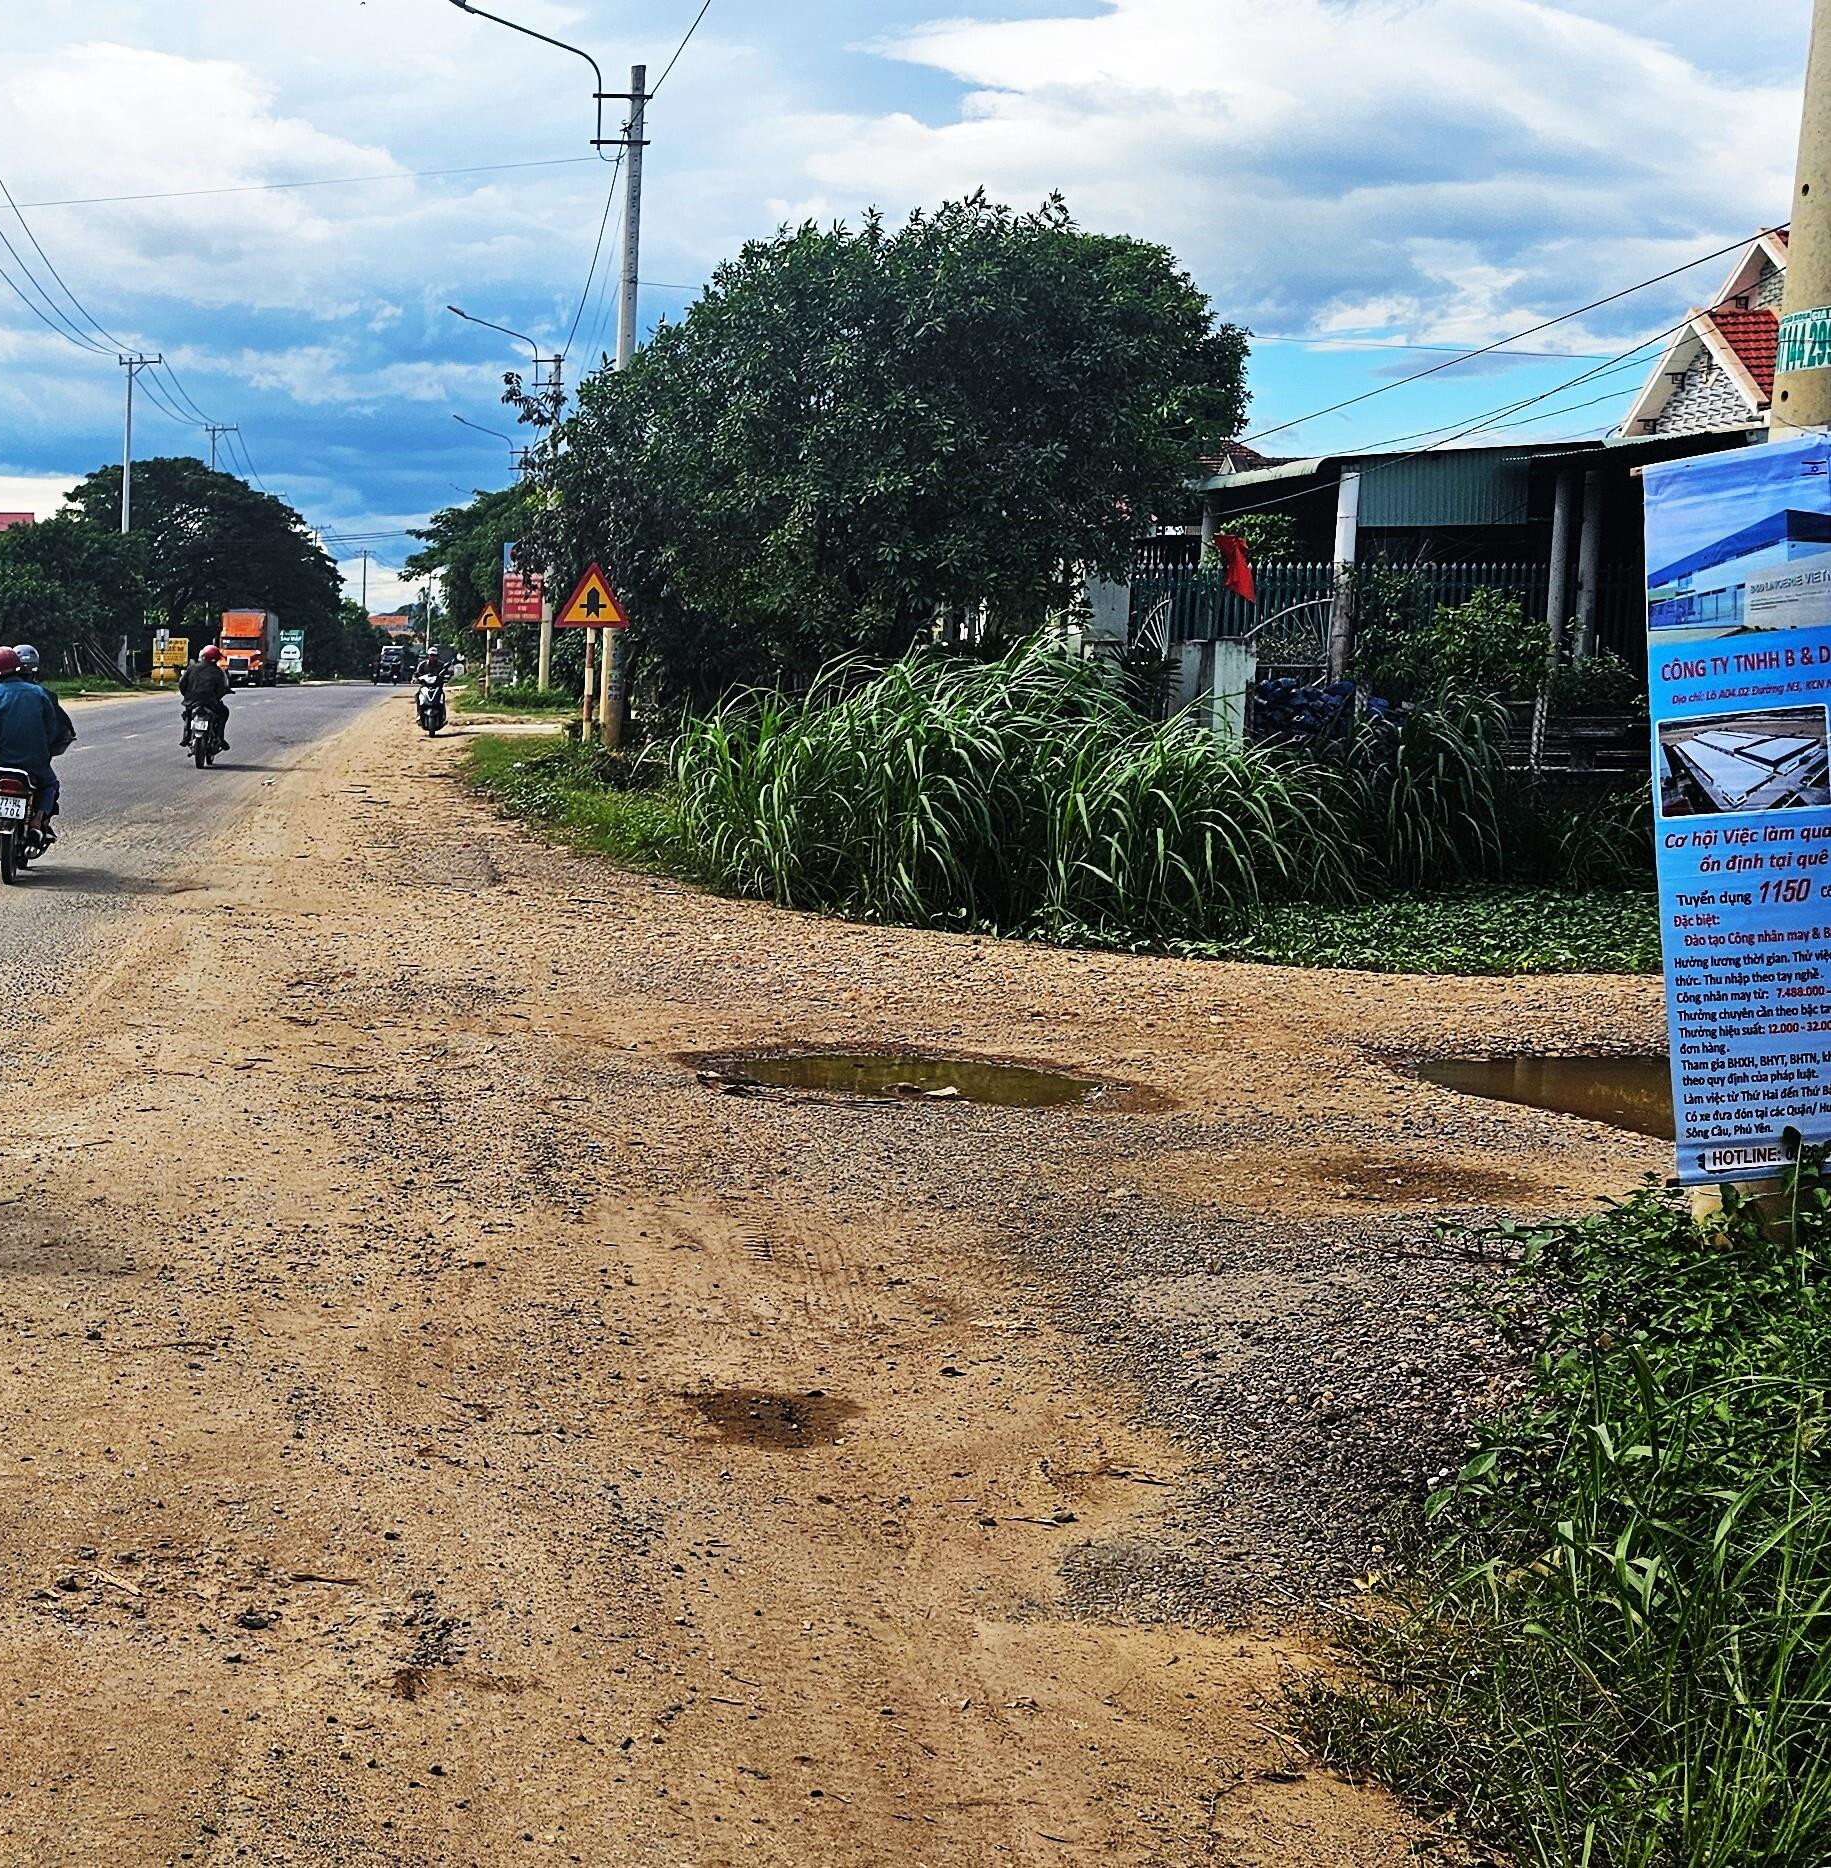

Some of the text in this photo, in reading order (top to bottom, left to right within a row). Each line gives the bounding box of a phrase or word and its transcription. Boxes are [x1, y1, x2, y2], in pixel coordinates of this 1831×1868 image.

[1661, 657, 1706, 681] CÔNG
[1710, 656, 1729, 675] TY
[1733, 650, 1780, 673] TNHH
[1785, 649, 1795, 667] B
[1800, 647, 1814, 665] &
[1665, 833, 1688, 848] Cơ
[1692, 829, 1717, 849] hội
[1723, 827, 1759, 846] Việc
[1763, 826, 1794, 842] làm
[1726, 853, 1763, 873] định
[1769, 852, 1793, 870] tại
[1796, 848, 1829, 869] quê
[1676, 889, 1715, 908] Tuyển
[1719, 891, 1752, 906] dụng
[1760, 878, 1811, 904] 1150
[1674, 913, 1720, 929] Đặc biệt:
[1684, 934, 1706, 946] Đào
[1708, 933, 1725, 947] tạo
[1727, 931, 1755, 946] Công
[1757, 930, 1784, 943] nhân
[1787, 930, 1810, 942] may
[1811, 927, 1821, 939] &
[1711, 955, 1742, 968] lương
[1742, 952, 1764, 966] thời
[1766, 952, 1790, 967] gian.
[1675, 975, 1701, 987] thức.
[1703, 973, 1722, 985] Thu
[1725, 972, 1750, 986] nhập
[1752, 971, 1775, 983] theo
[1776, 971, 1793, 983] tay
[1676, 992, 1702, 1005] Công
[1703, 990, 1728, 1002] nhân
[1730, 991, 1751, 1002] may
[1719, 1007, 1755, 1022] chuyên
[1775, 1005, 1798, 1017] theo
[1800, 1003, 1818, 1017] bậc
[1719, 1024, 1741, 1038] hiệu
[1768, 1022, 1799, 1034] 12.000
[1679, 1041, 1730, 1056] đơn hàng.
[1681, 1059, 1709, 1071] Tham
[1710, 1058, 1725, 1072] gia
[1728, 1057, 1758, 1069] BHXH,
[1760, 1054, 1788, 1067] BHYT,
[1790, 1052, 1821, 1065] BHTN,
[1682, 1075, 1705, 1086] theo
[1707, 1075, 1726, 1087] quy
[1727, 1072, 1749, 1086] định
[1770, 1069, 1795, 1084] pháp
[1796, 1067, 1819, 1081] luật.
[1684, 1093, 1704, 1105] Làm
[1706, 1092, 1725, 1105] việc
[1727, 1091, 1739, 1103] từ
[1740, 1090, 1761, 1102] Thứ
[1762, 1088, 1778, 1101] Hai
[1780, 1086, 1798, 1099] đến
[1801, 1084, 1821, 1097] Thứ
[1685, 1110, 1698, 1123] Có
[1699, 1113, 1711, 1122] xe
[1712, 1109, 1732, 1121] đưa
[1734, 1108, 1754, 1120] đón
[1755, 1107, 1768, 1120] tại
[1769, 1106, 1785, 1118] các
[1685, 1126, 1710, 1139] Sông
[1712, 1147, 1781, 1166] HOTLINE:
